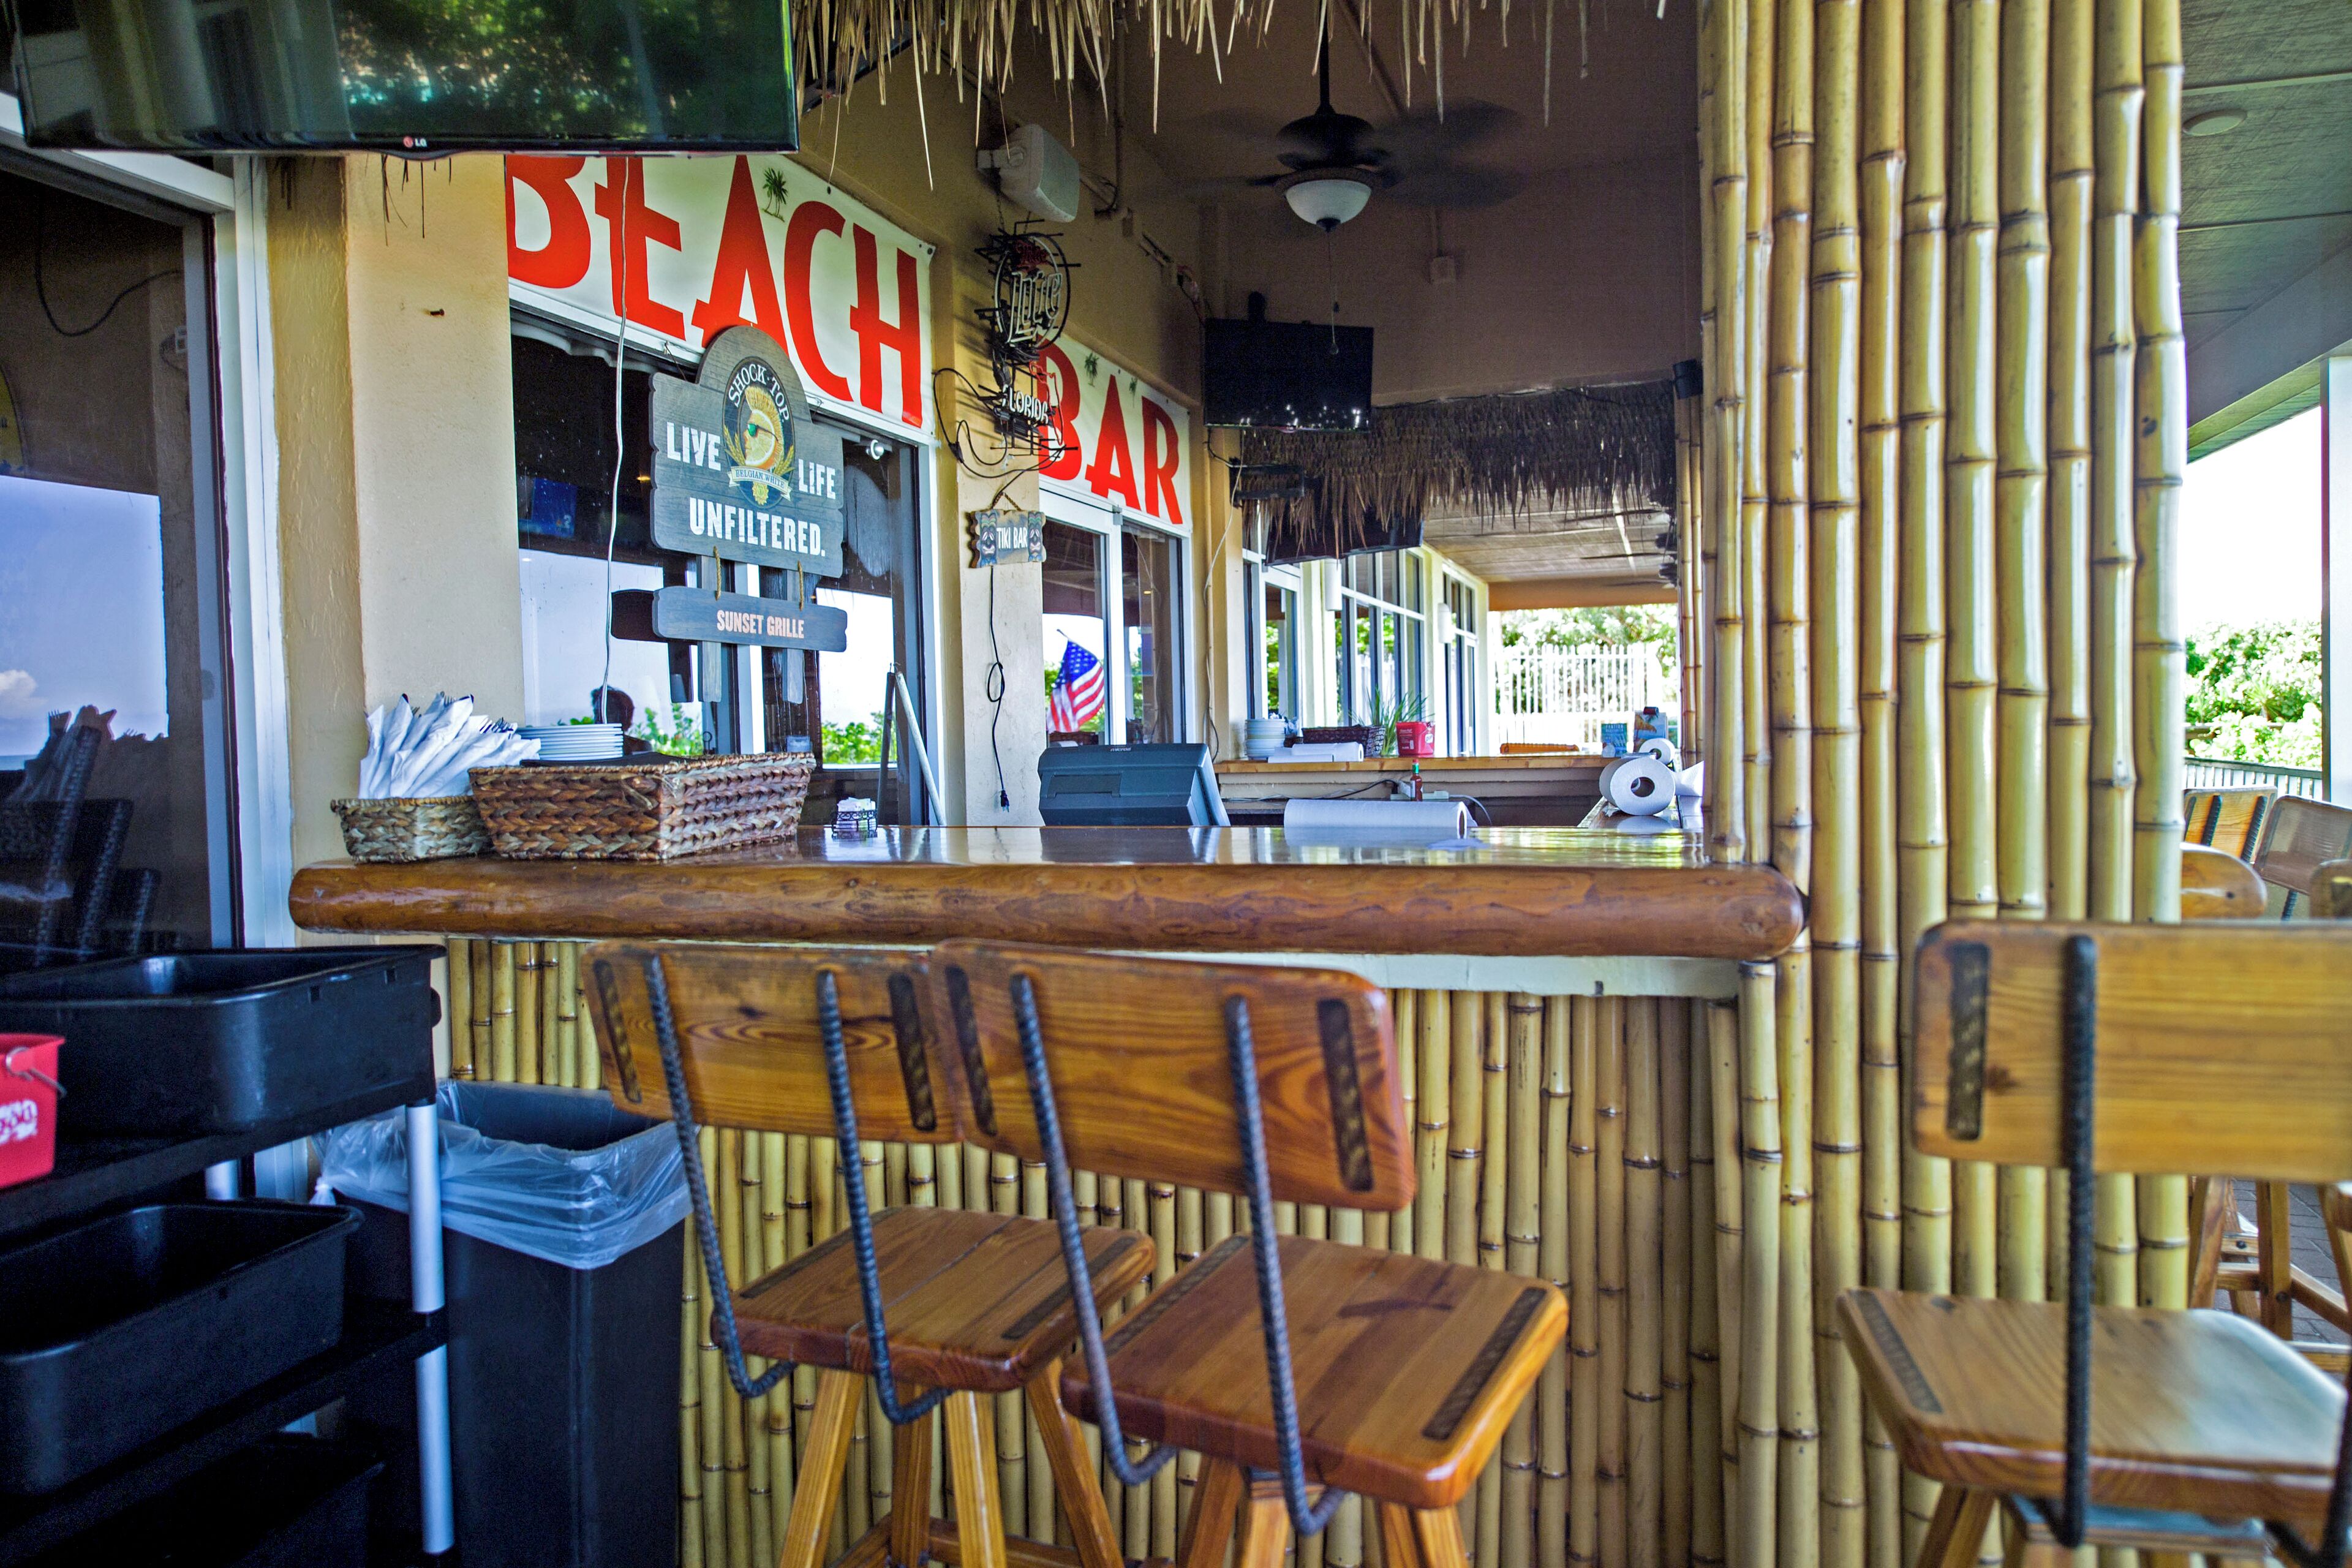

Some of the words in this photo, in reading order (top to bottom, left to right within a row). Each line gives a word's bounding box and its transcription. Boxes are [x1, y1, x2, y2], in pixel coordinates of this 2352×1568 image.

[414, 138, 428, 148] LG
[505, 154, 922, 429] BEACH
[1005, 270, 1063, 344] Lite
[1036, 334, 1183, 524] BAR
[666, 421, 721, 472] LIVE
[798, 459, 835, 499] LIFE
[736, 469, 764, 480] BELGIAN
[765, 473, 785, 488] WHITE
[689, 497, 826, 557] UNFILTERED.
[996, 527, 1011, 549] TIKI
[1013, 527, 1028, 549] BAR
[717, 609, 764, 635] SUNSET
[767, 615, 805, 638] GRILLE
